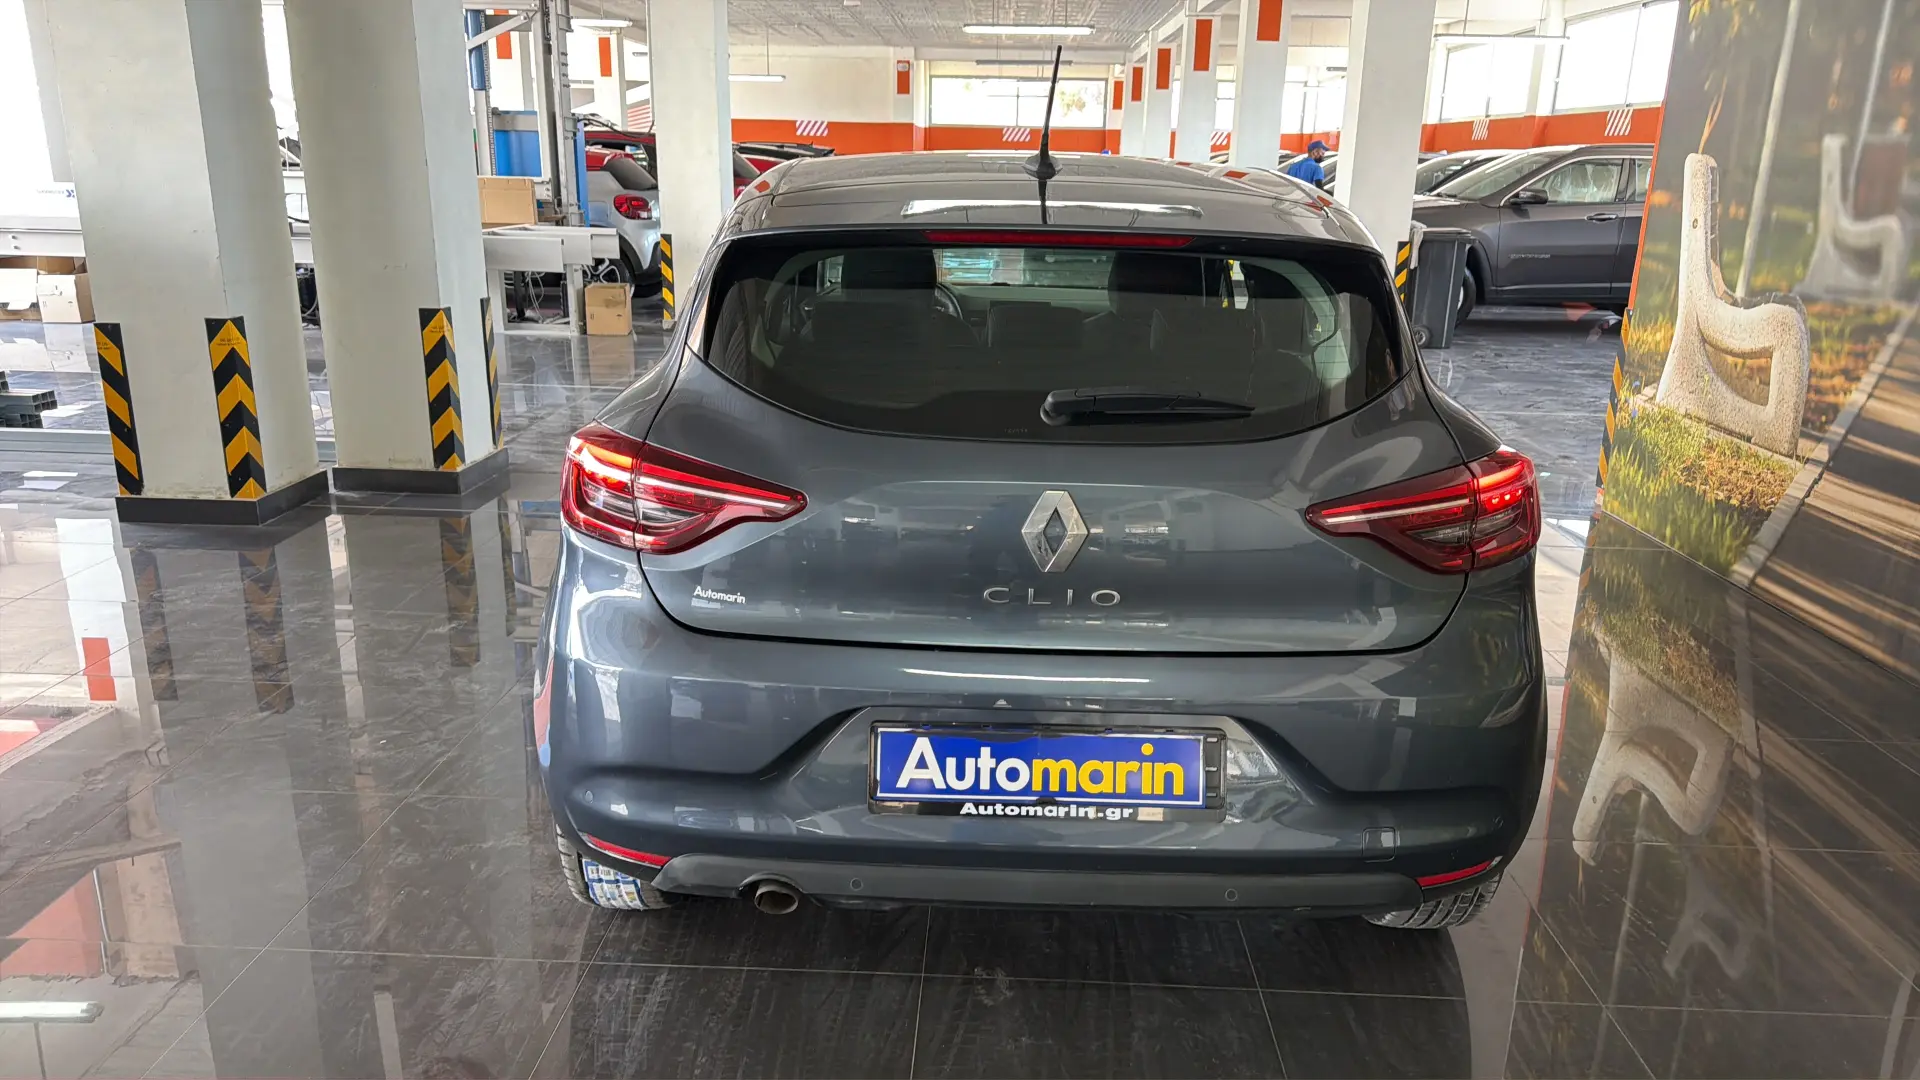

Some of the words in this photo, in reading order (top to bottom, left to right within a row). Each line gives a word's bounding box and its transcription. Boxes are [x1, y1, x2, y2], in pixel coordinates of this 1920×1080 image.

[693, 585, 746, 604] Automarin
[983, 586, 1121, 607] CLIO
[895, 736, 1184, 796] Automarin
[959, 802, 1134, 821] Automarin.gr
